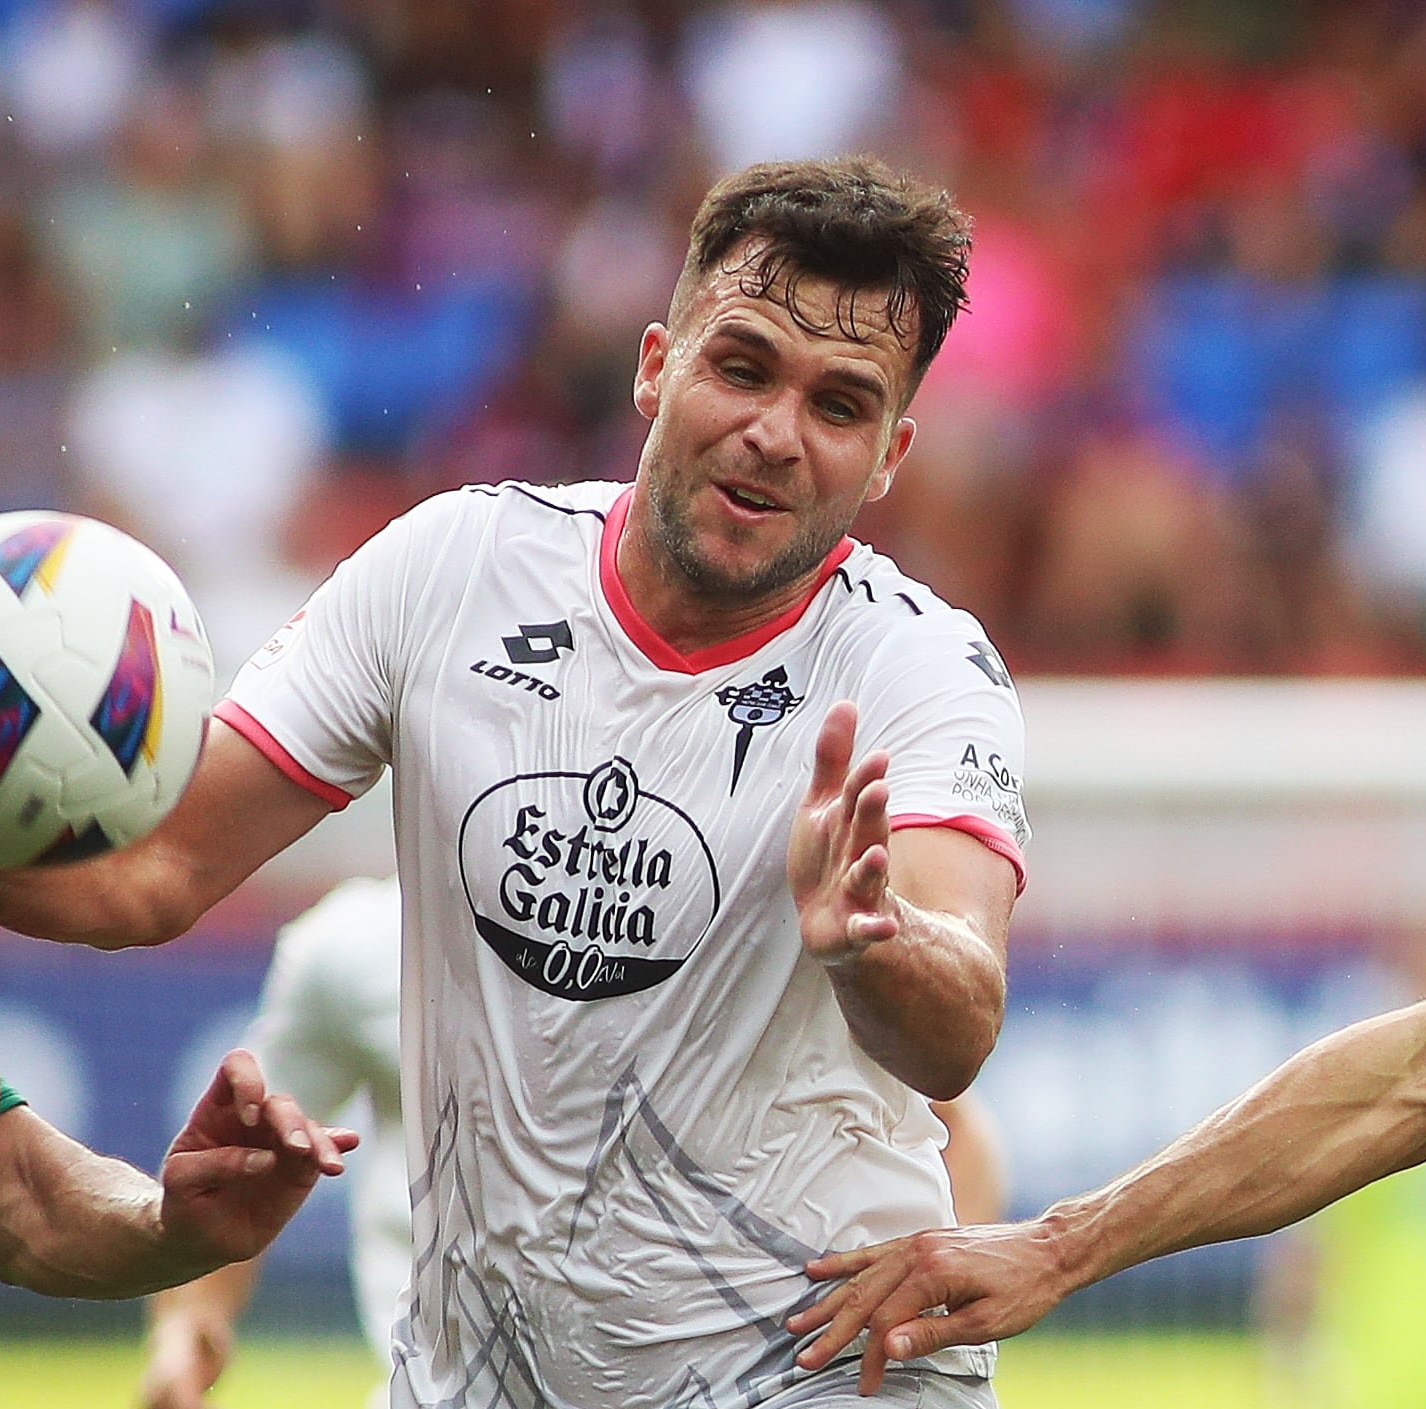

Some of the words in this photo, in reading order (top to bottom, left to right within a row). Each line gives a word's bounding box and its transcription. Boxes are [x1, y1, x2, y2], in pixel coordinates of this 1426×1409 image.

[469, 660, 561, 701] LOTTO
[961, 743, 980, 769] A
[502, 804, 673, 889] Estrella
[500, 862, 656, 947] Galicia
